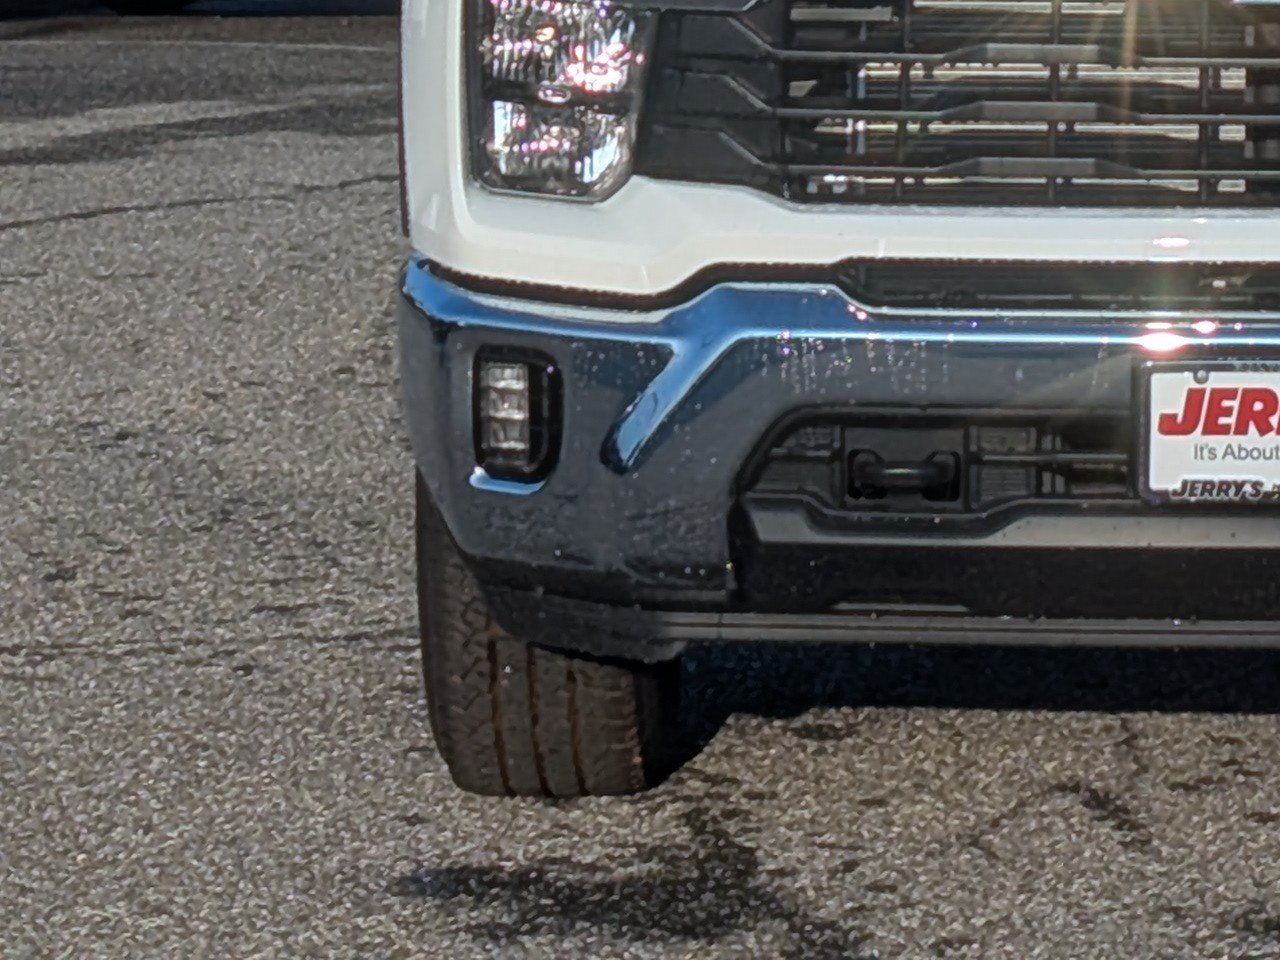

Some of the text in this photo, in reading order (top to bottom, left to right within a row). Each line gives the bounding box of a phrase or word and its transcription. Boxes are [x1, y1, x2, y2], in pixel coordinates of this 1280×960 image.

[1193, 443, 1217, 460] It's
[1222, 442, 1280, 461] About
[1171, 478, 1264, 499] JERRY'S
